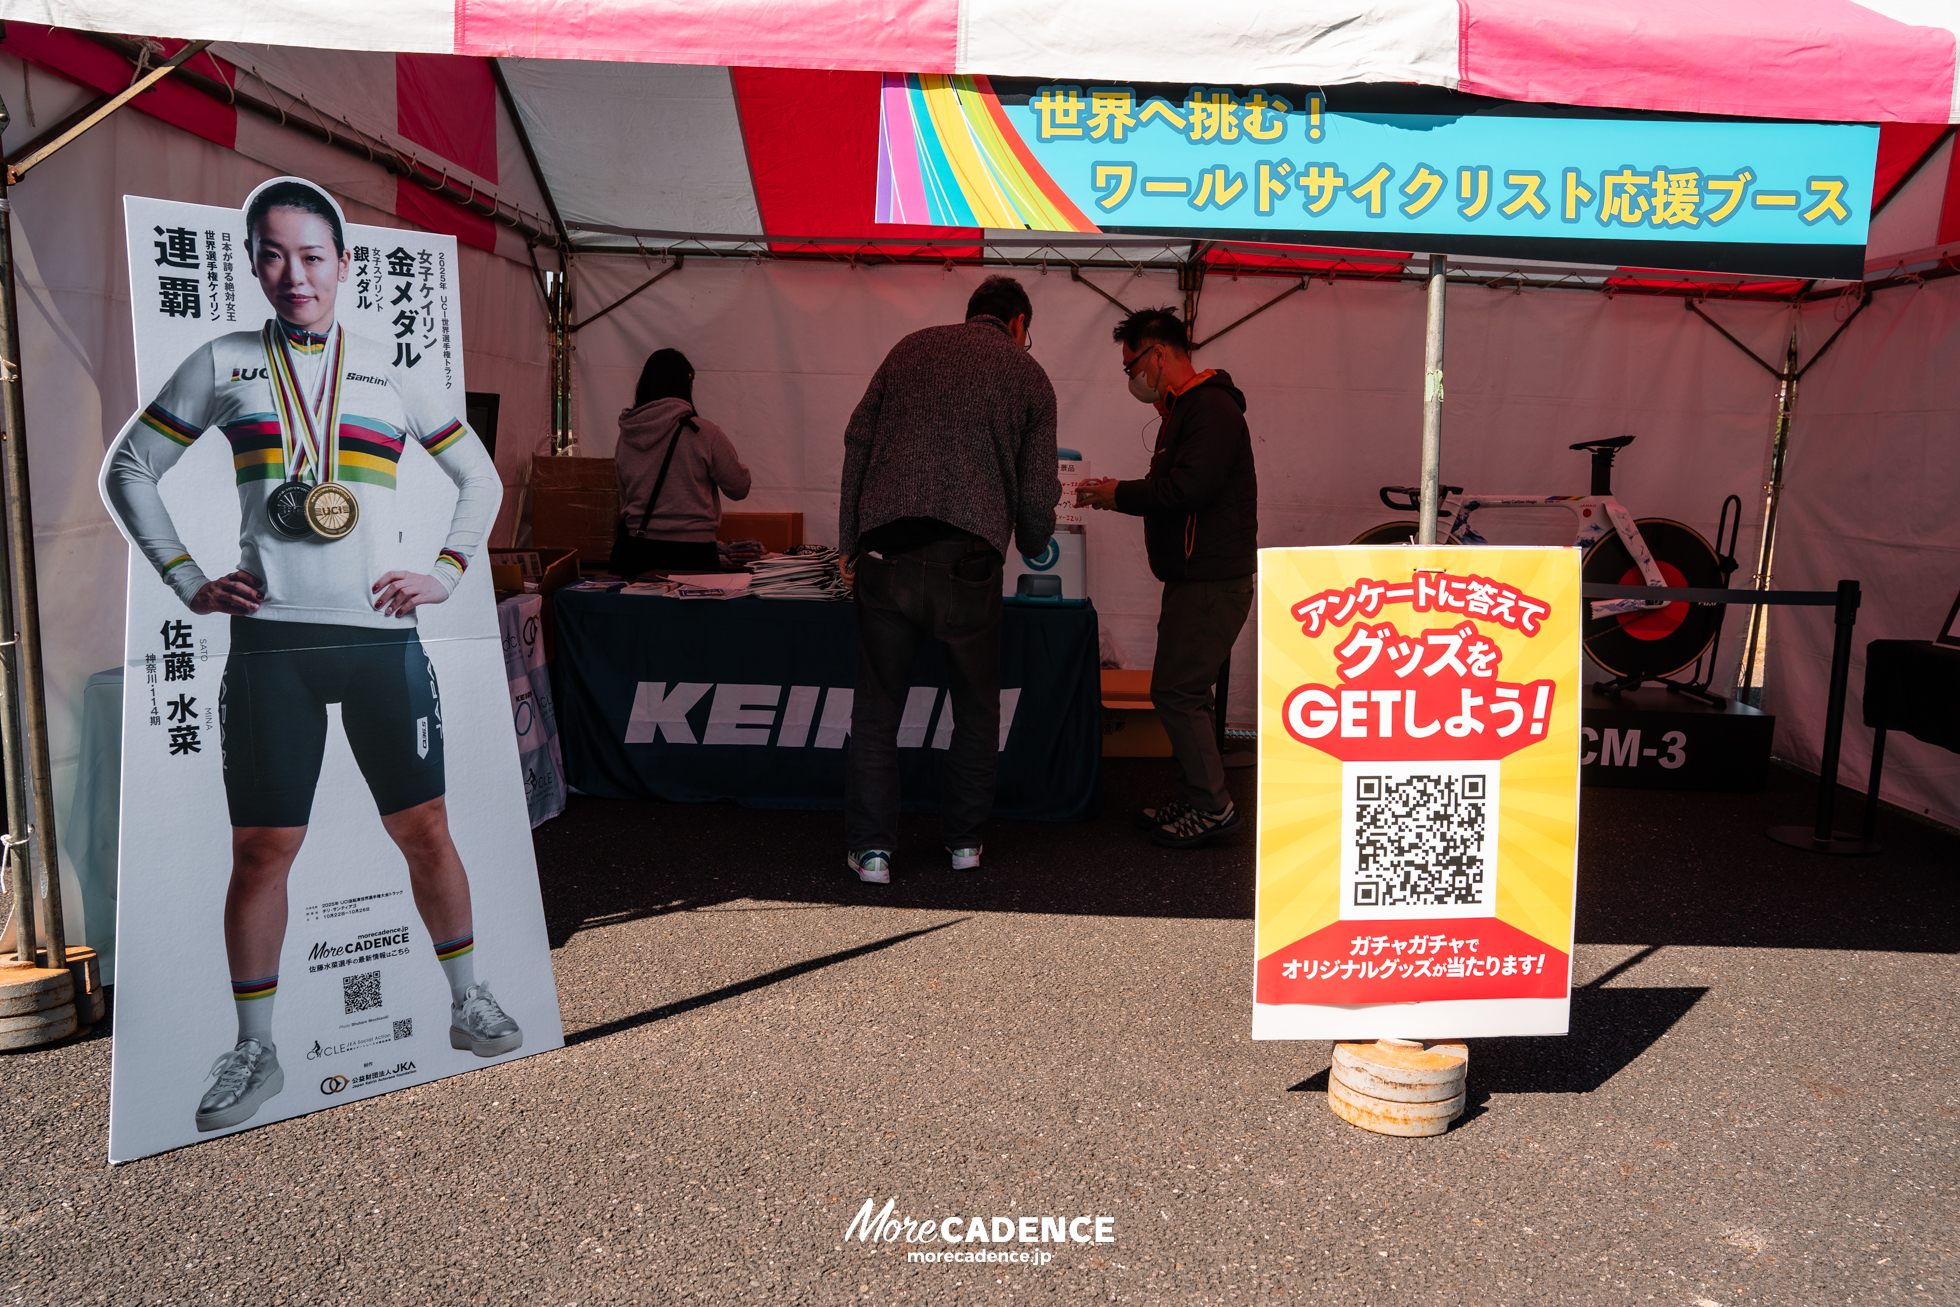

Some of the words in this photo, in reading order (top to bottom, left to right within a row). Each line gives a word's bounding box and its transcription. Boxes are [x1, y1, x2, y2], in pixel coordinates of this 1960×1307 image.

[1095, 162, 1848, 225] ワールドサイクリスト応援ブース
[153, 225, 201, 318] 連覇
[204, 230, 220, 322] 世界選手権ケイリン
[221, 232, 237, 322] 日本が誇る絶対女王
[353, 245, 372, 310] 銀メダル
[371, 247, 384, 312] 女子スプリント
[417, 249, 438, 350] 女子ケイリン
[438, 252, 448, 290] 2025年
[385, 246, 422, 369] 金メダル
[440, 296, 452, 390] UCI世界選手権トラック
[346, 372, 388, 387] Santini
[1297, 577, 1545, 632] アンケートに答えて
[159, 620, 196, 682] 佐藤
[1340, 627, 1496, 679] グッズを
[199, 638, 208, 662] SATO
[205, 707, 213, 731] MINA
[1288, 685, 1550, 739] GETしよう!
[166, 693, 202, 756] 水菜
[309, 947, 410, 973] 佐藤水菜選手の最新情報はこちら
[357, 926, 409, 940] morecadence.jp
[1349, 934, 1480, 957] ガチャガチャで
[351, 1069, 392, 1084] 公益財団法人
[392, 1061, 417, 1074] JKA
